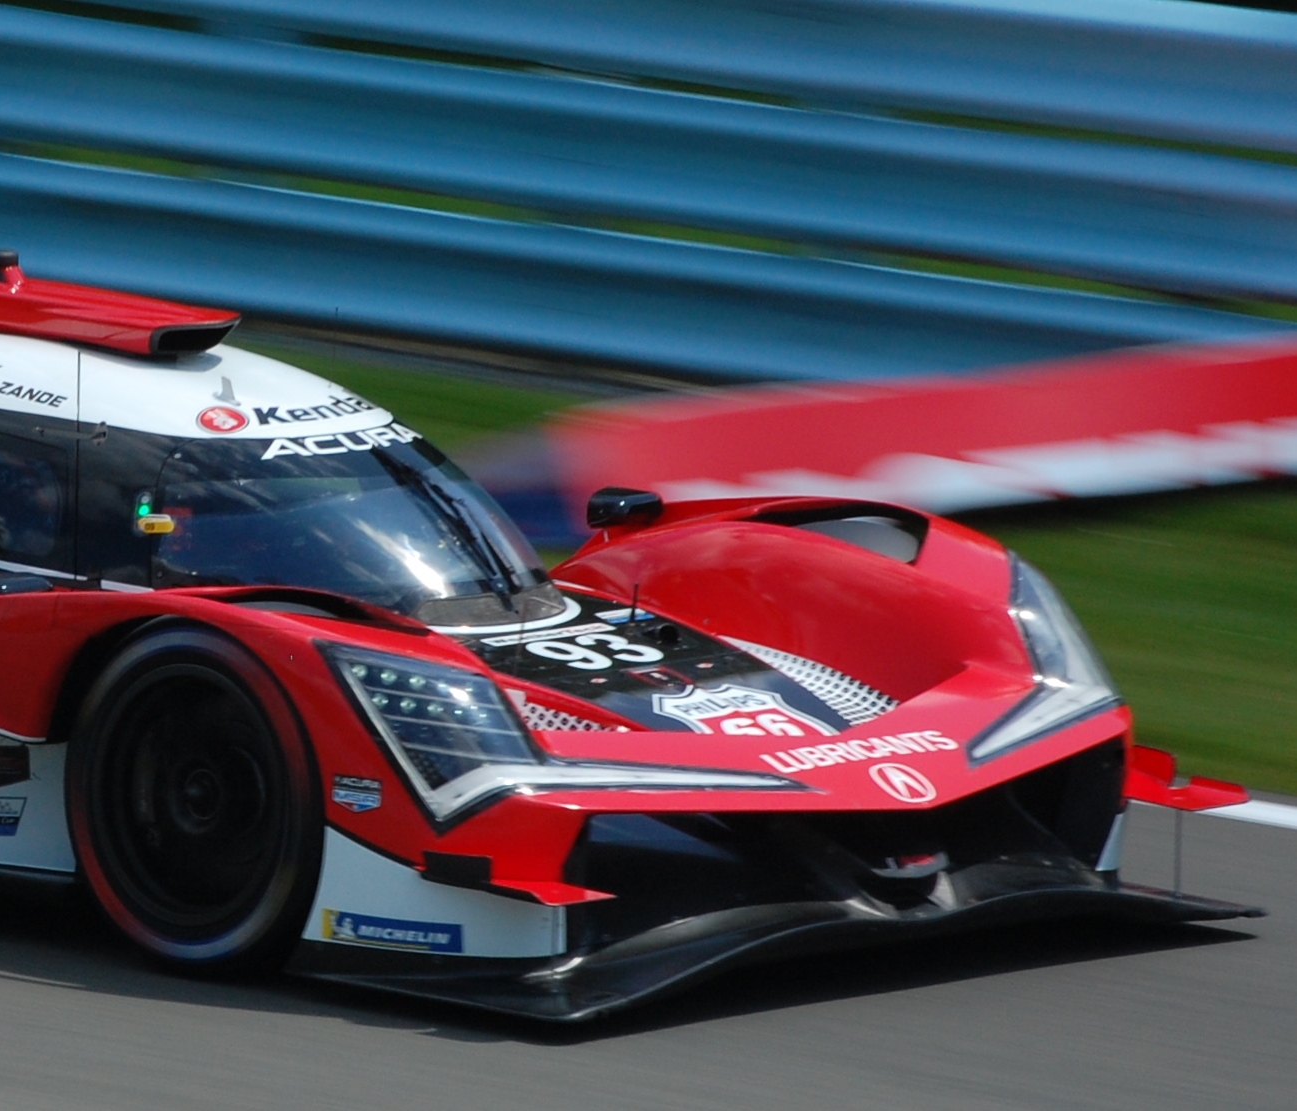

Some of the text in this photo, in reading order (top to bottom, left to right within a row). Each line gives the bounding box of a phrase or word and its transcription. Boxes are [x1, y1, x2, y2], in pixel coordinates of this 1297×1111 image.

[260, 422, 423, 460] ACURA
[525, 633, 664, 670] 93
[759, 730, 959, 774] LUBRICANTS
[357, 925, 452, 945] MICHELIN
